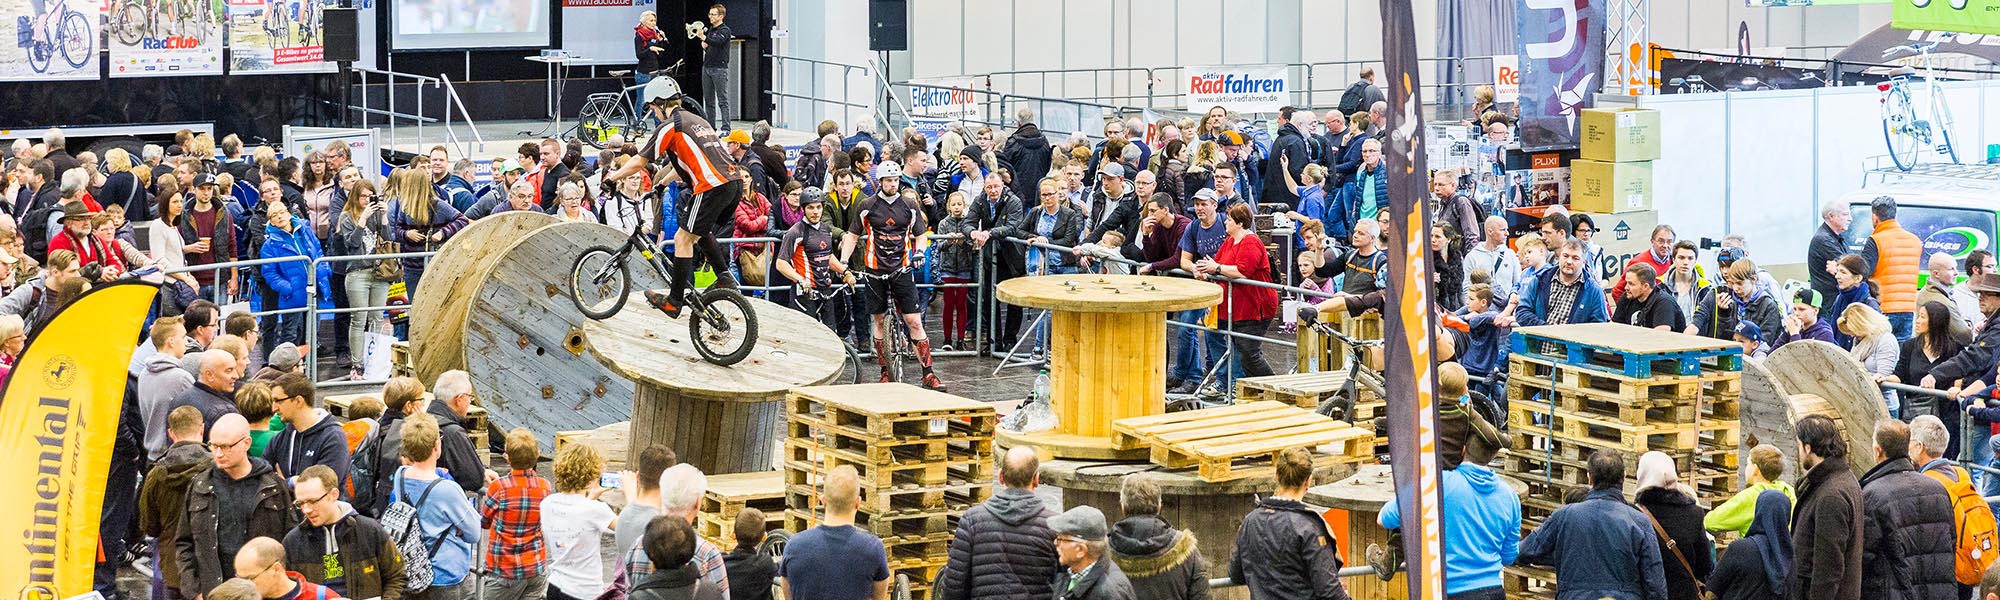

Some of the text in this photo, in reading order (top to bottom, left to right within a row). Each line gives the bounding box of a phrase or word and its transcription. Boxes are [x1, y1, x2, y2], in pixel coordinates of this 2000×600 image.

[143, 36, 198, 50] RadClub
[1190, 74, 1283, 94] Radfahren
[1197, 95, 1278, 103] www.aktiv-radfahren.de
[66, 482, 76, 517] THE
[72, 433, 82, 476] GRIP
